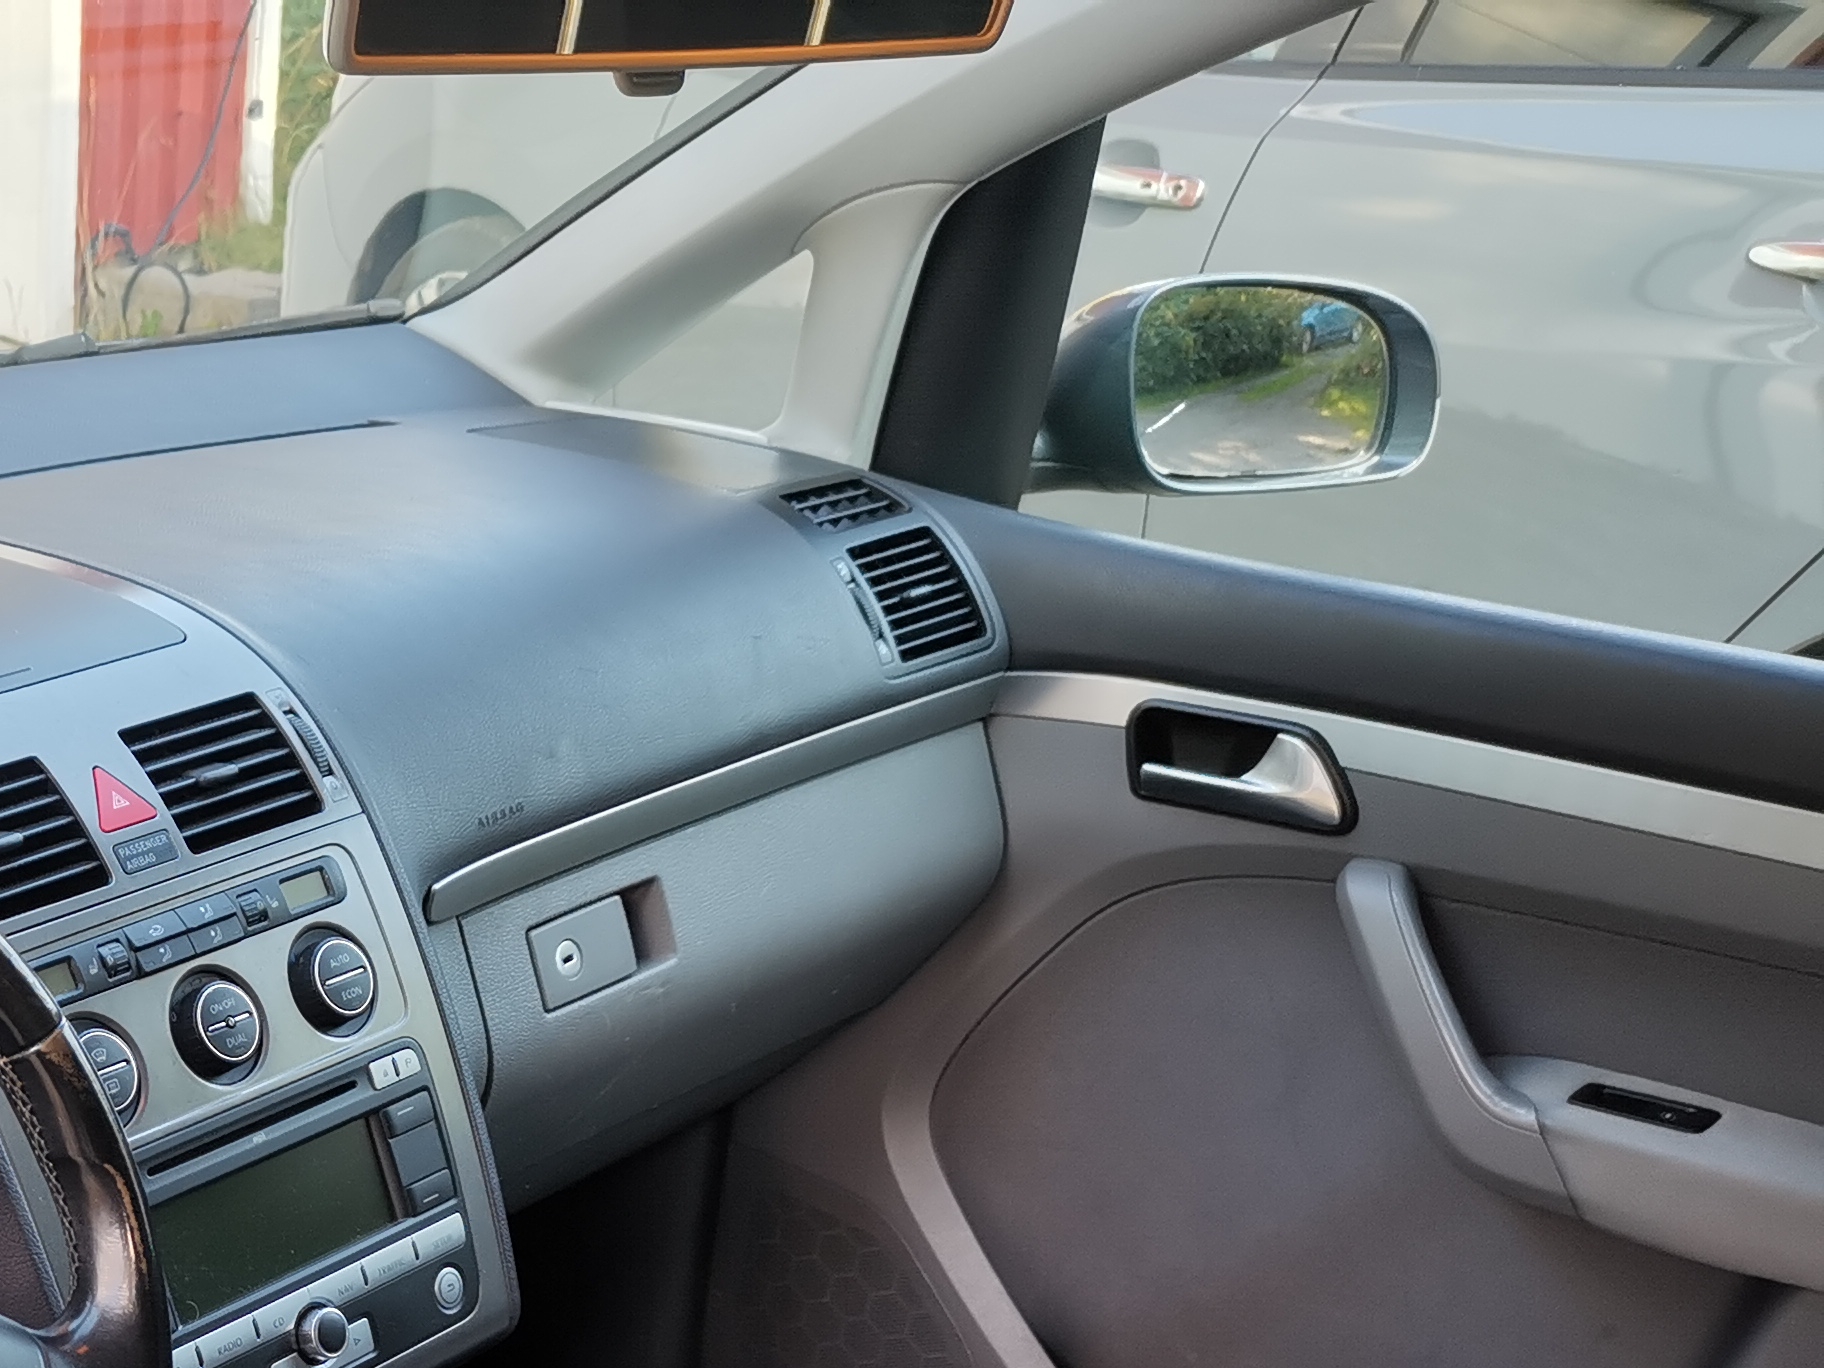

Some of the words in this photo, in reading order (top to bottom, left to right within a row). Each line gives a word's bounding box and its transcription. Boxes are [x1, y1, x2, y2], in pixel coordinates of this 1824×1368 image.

[118, 834, 169, 858] PASSENGER
[126, 852, 156, 870] AIRBAG
[329, 953, 350, 969] AUTO
[341, 986, 363, 1001] ECON
[226, 1033, 249, 1048] DUAL
[338, 1282, 356, 1297] NAV
[273, 1316, 285, 1329] CD
[217, 1336, 243, 1356] RADIO
